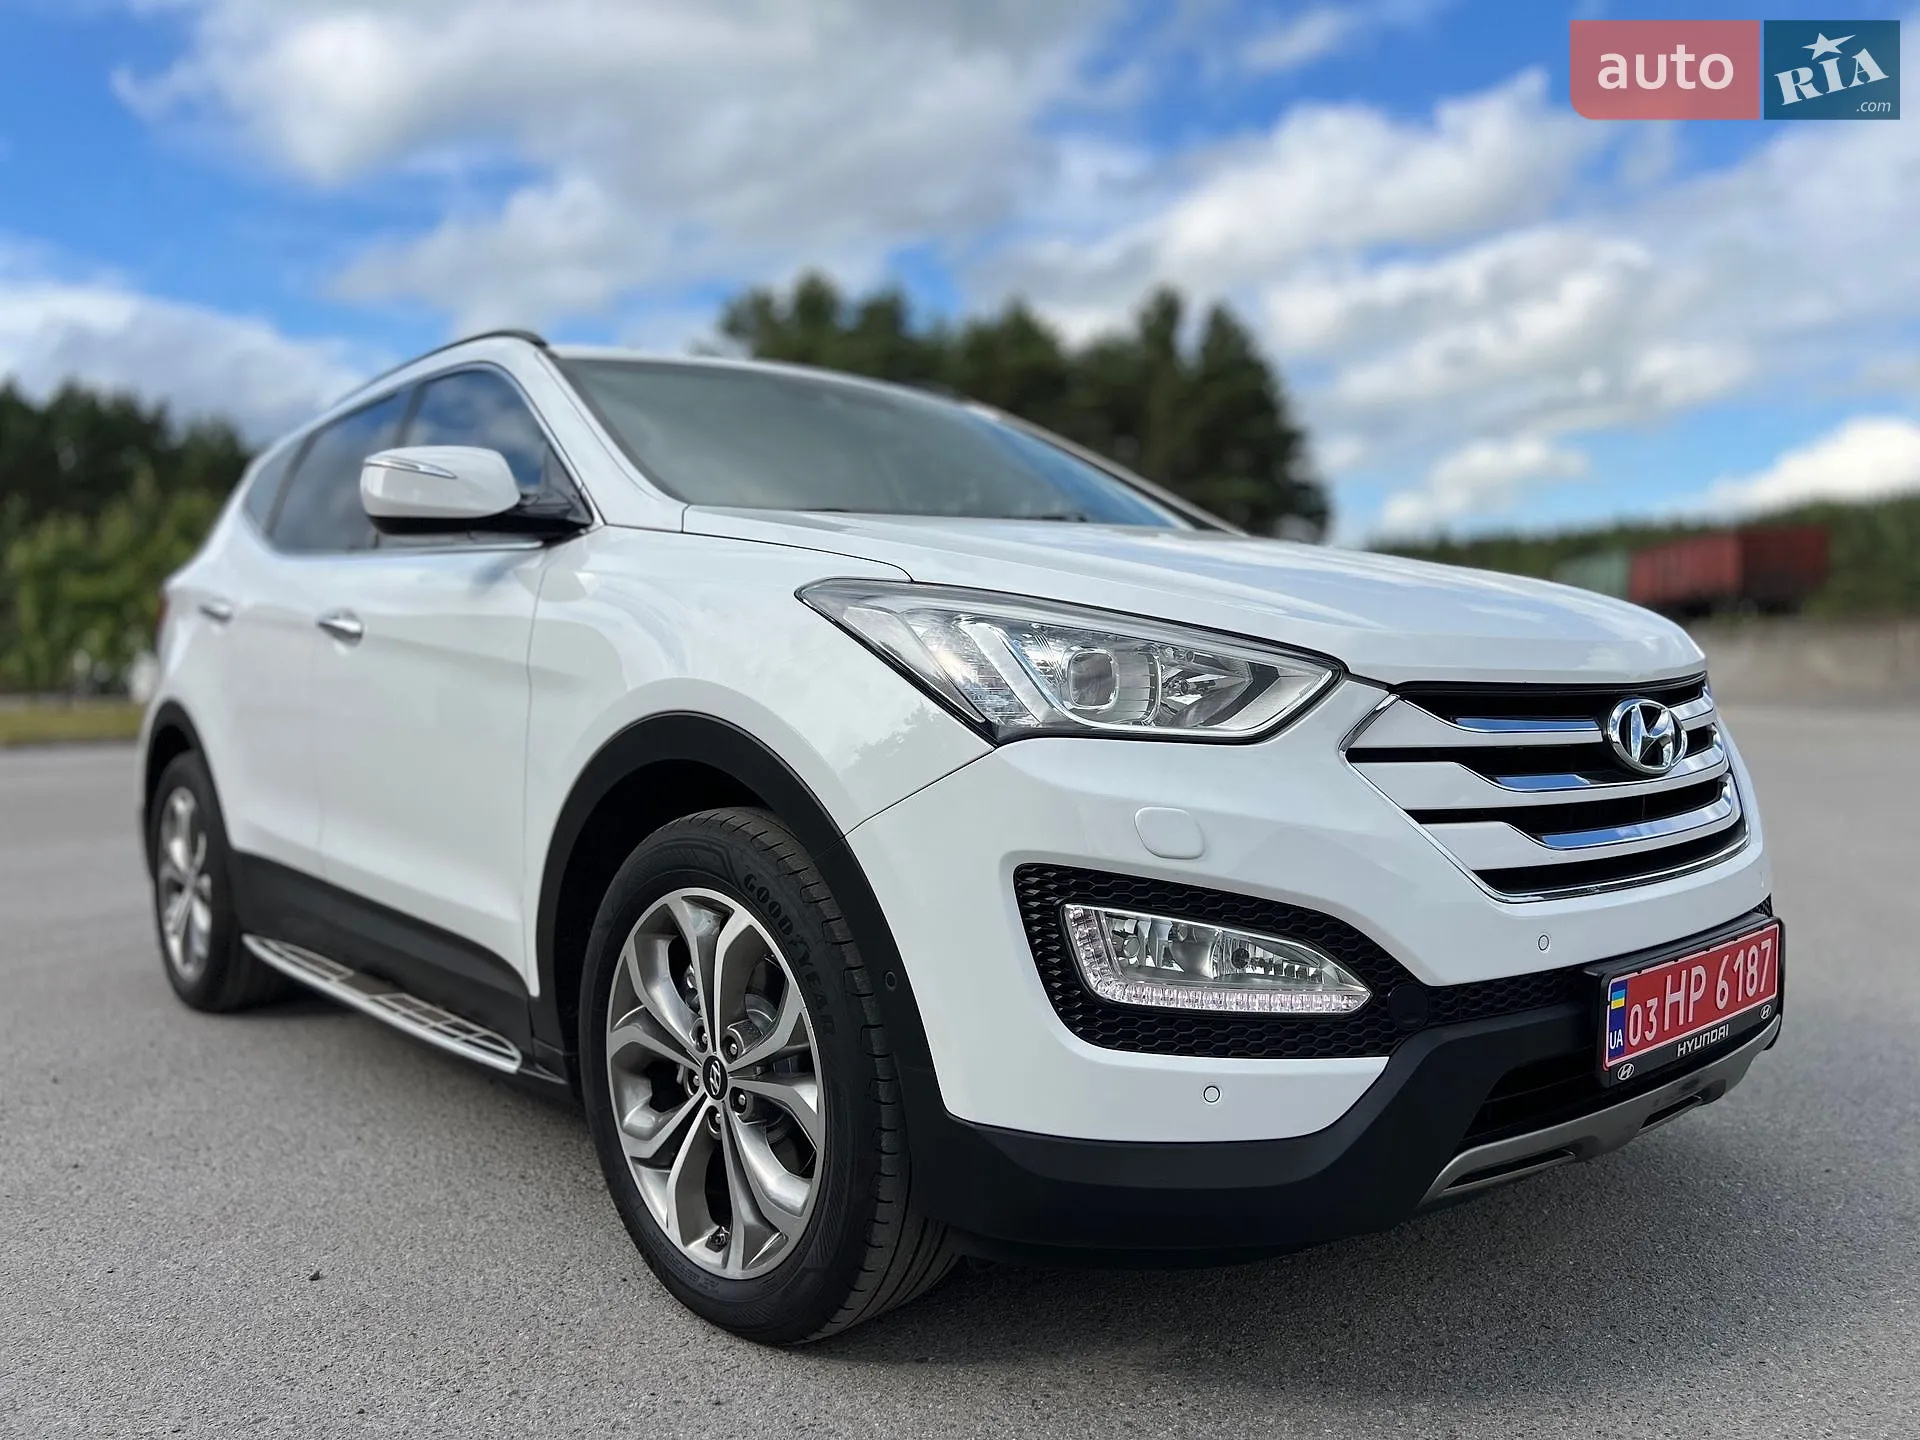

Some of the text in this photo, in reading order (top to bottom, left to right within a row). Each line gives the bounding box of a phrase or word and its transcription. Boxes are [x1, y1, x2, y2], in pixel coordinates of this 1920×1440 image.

[1628, 938, 1772, 1047] 03 HP 6187
[1609, 1029, 1624, 1050] UA
[1677, 1024, 1729, 1058] HYUNDAI
